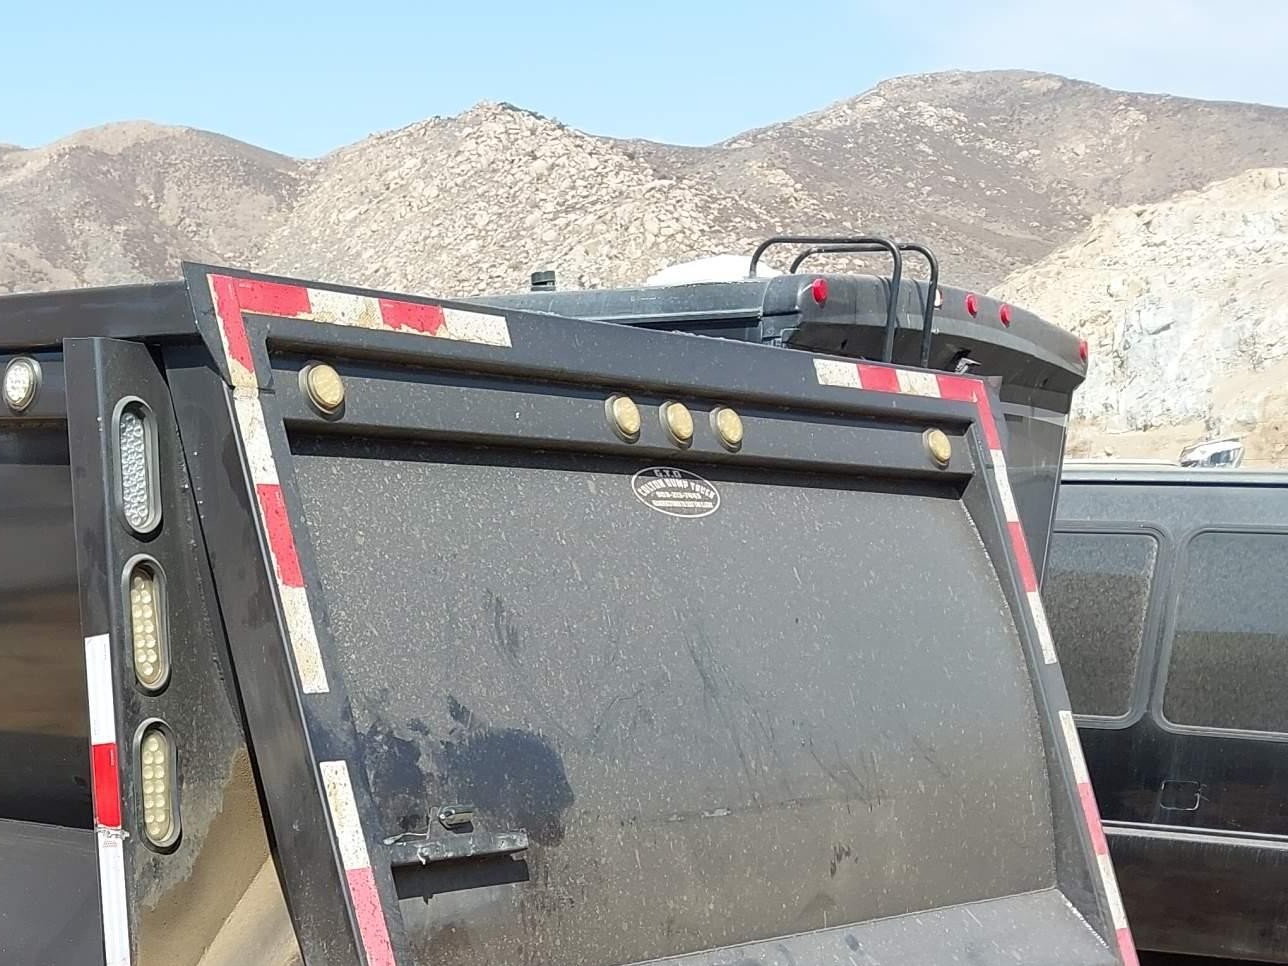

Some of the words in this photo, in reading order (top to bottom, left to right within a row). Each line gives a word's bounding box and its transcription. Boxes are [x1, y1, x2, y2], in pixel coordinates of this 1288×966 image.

[636, 479, 666, 497] COLTON
[664, 478, 689, 489] DUMP
[690, 481, 716, 499] TRUCK
